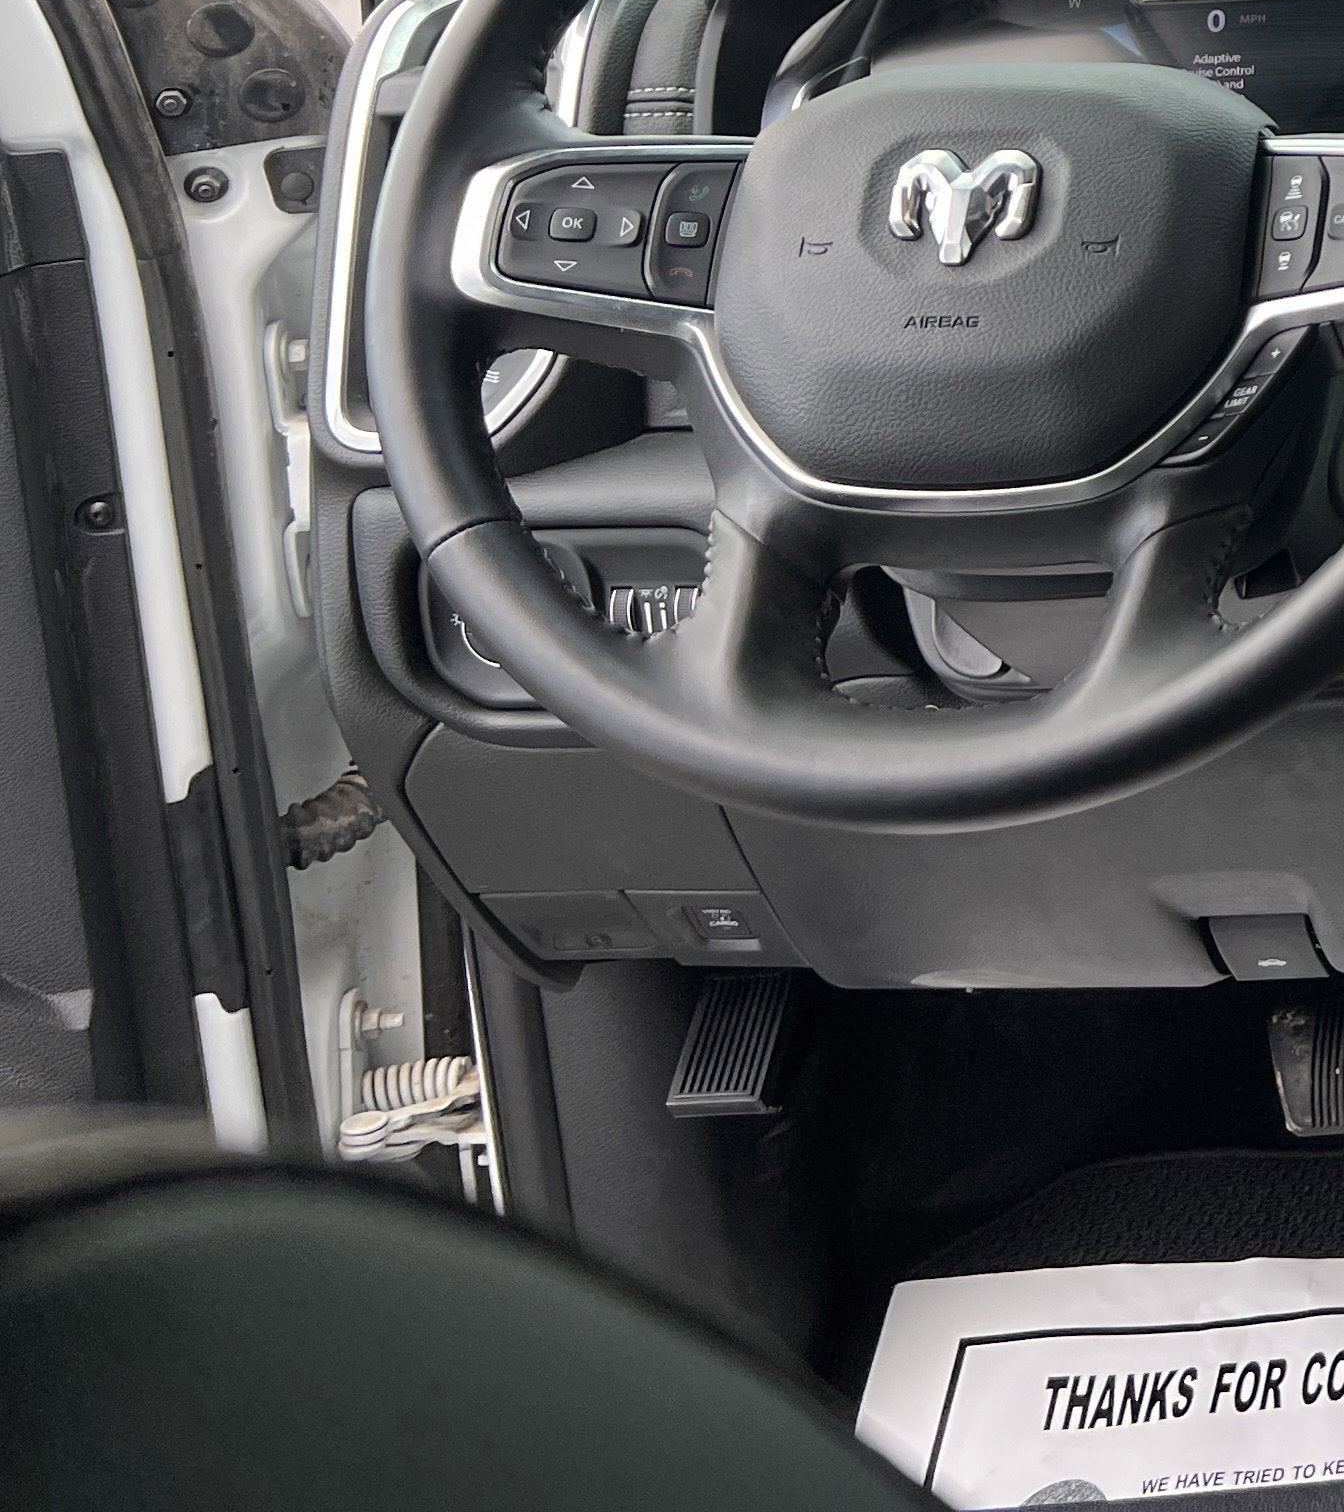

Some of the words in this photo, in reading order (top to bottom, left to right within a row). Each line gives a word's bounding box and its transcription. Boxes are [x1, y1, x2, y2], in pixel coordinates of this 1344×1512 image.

[1192, 53, 1242, 65] Adaptive
[1215, 65, 1255, 77] Control
[561, 216, 584, 230] OK
[903, 314, 981, 331] AIRBAG
[1233, 384, 1258, 397] GEAR
[1224, 396, 1251, 409] LIMIT
[1043, 1366, 1199, 1433] THANKS
[1209, 1353, 1287, 1415] FOR
[1141, 1478, 1170, 1494] WE
[1174, 1472, 1228, 1492] HAVE
[1232, 1467, 1287, 1487] TRIED
[1292, 1463, 1319, 1483] TO
